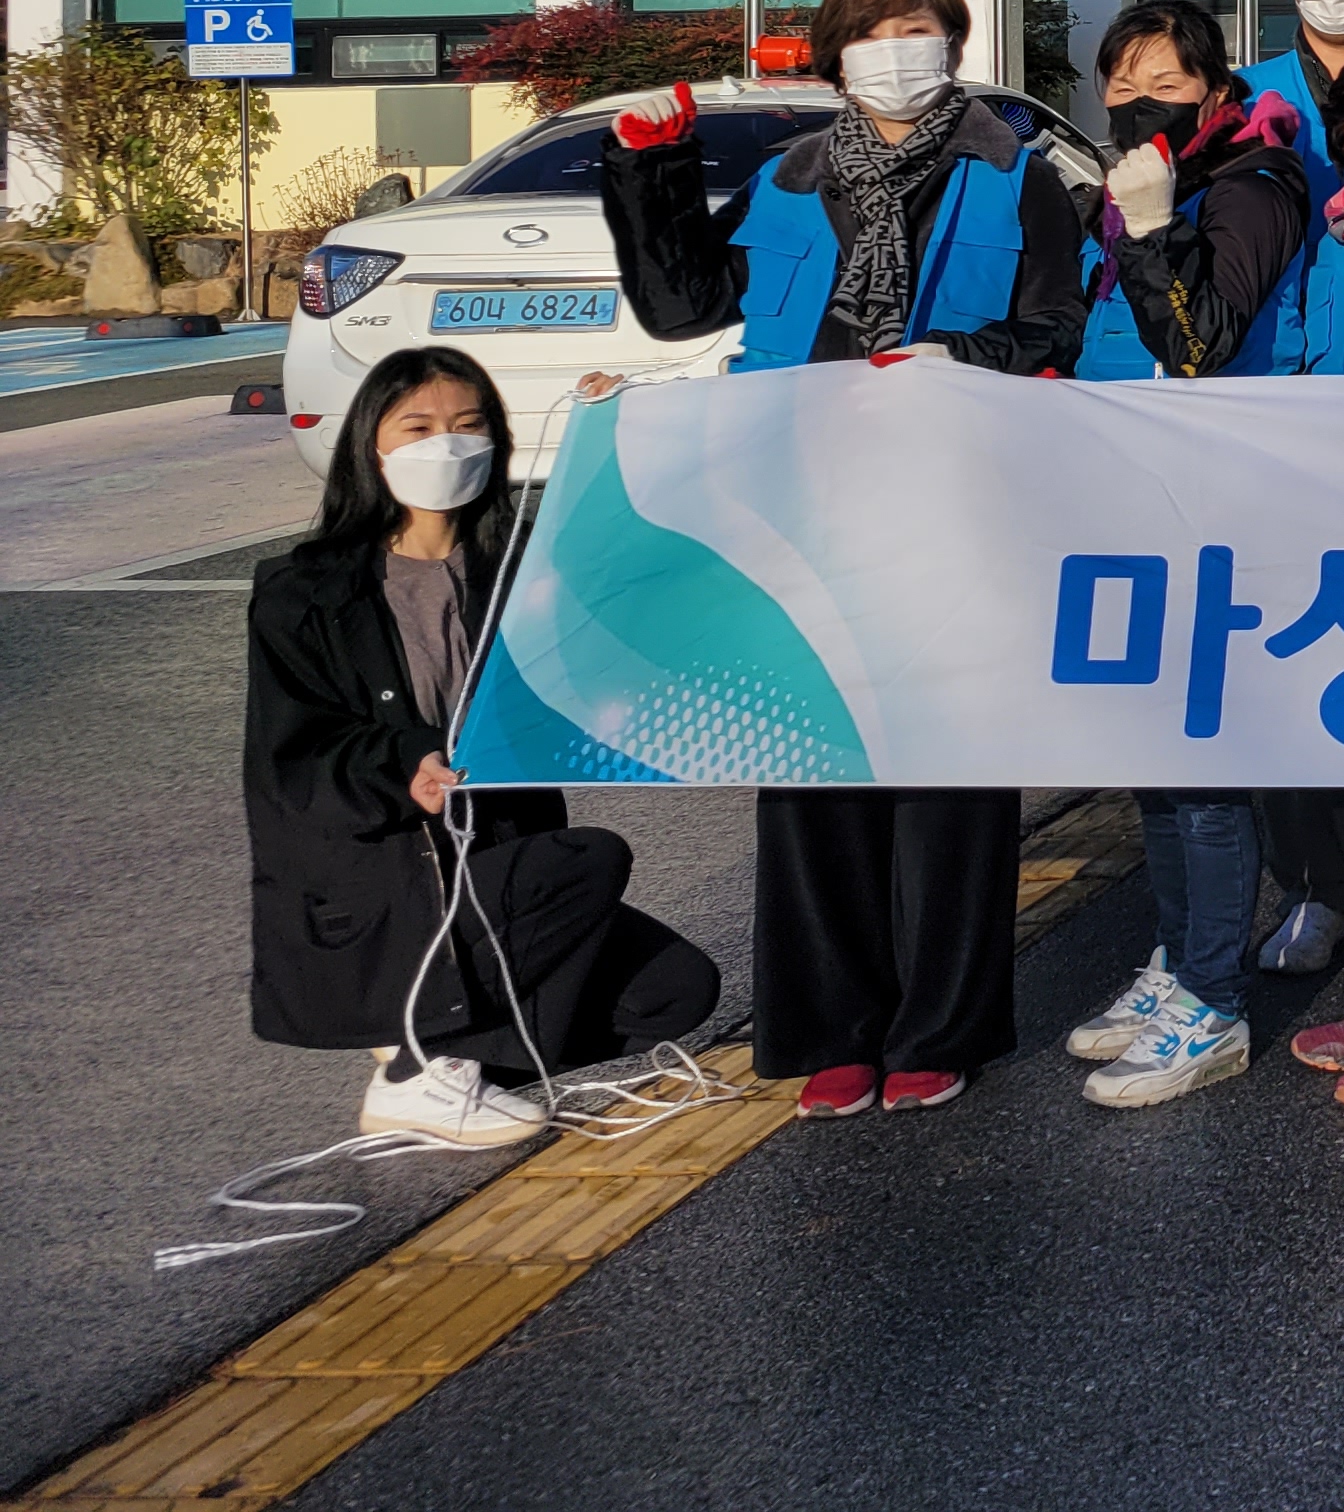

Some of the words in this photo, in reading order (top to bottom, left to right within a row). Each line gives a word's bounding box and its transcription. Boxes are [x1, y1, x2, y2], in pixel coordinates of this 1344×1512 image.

[204, 9, 231, 43] P
[344, 315, 392, 327] SM3
[449, 296, 505, 323] 60나
[520, 294, 599, 321] 6824
